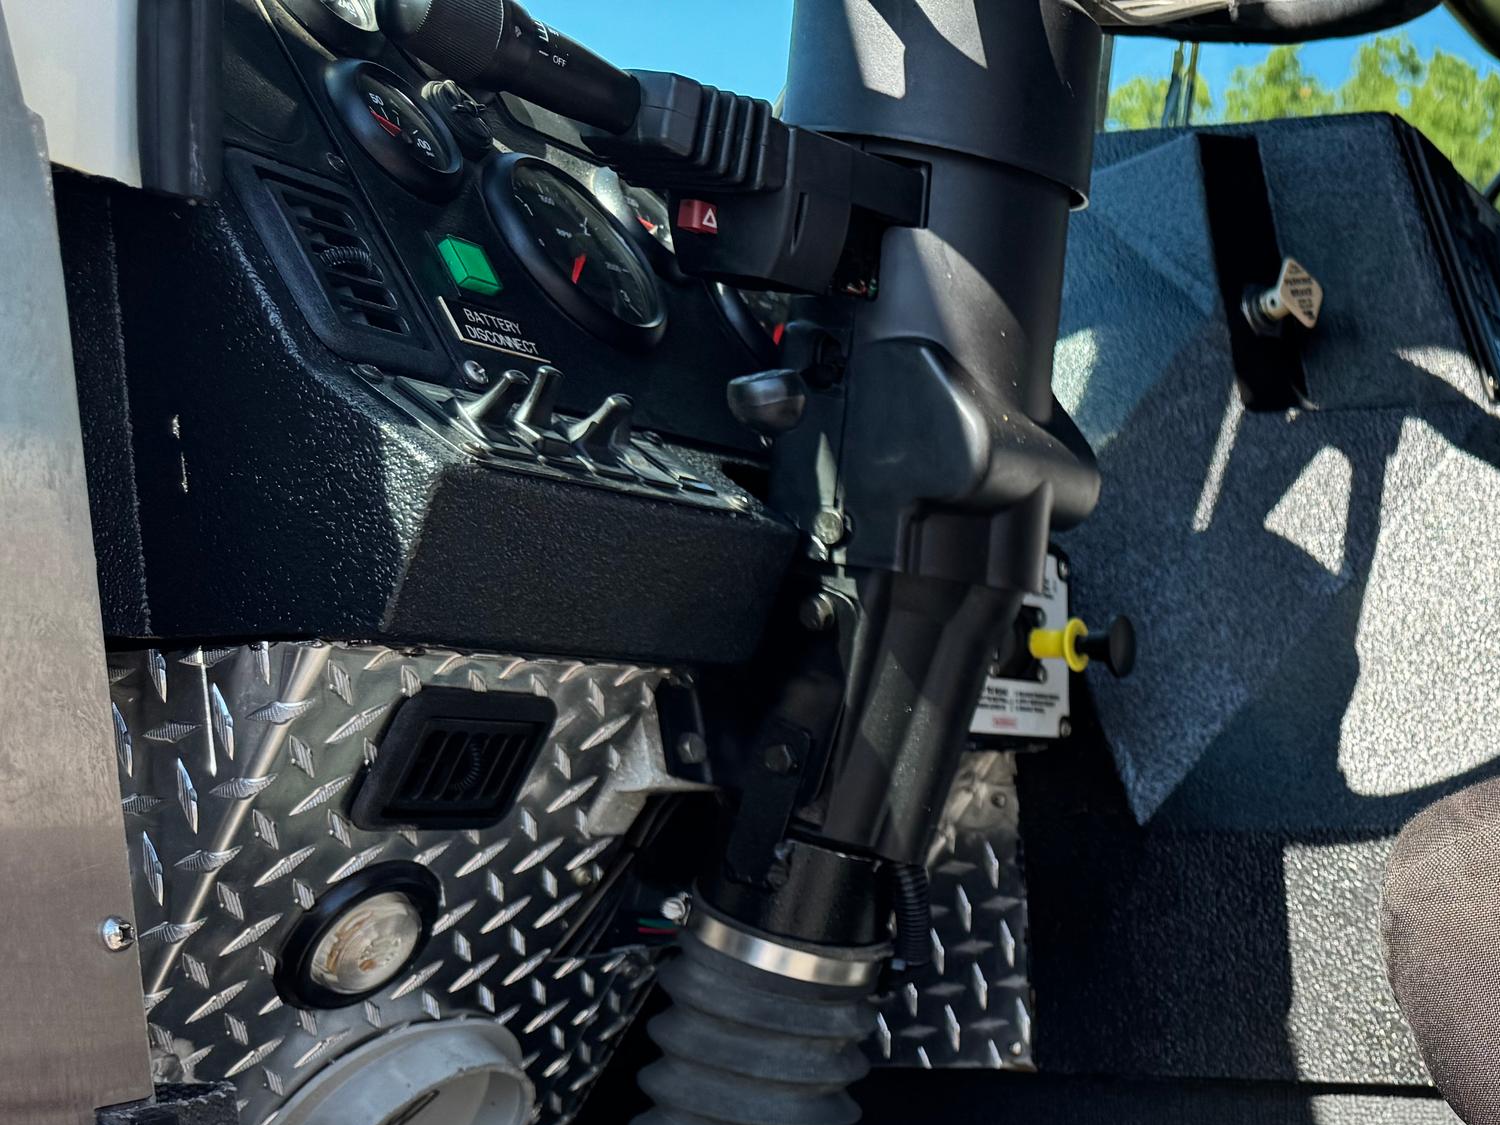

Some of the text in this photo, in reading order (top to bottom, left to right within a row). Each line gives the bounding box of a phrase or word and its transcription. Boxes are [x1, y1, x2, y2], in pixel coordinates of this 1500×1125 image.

[552, 54, 567, 67] OFF
[463, 307, 522, 335] BATTERY
[464, 324, 539, 355] DISCONNECT
